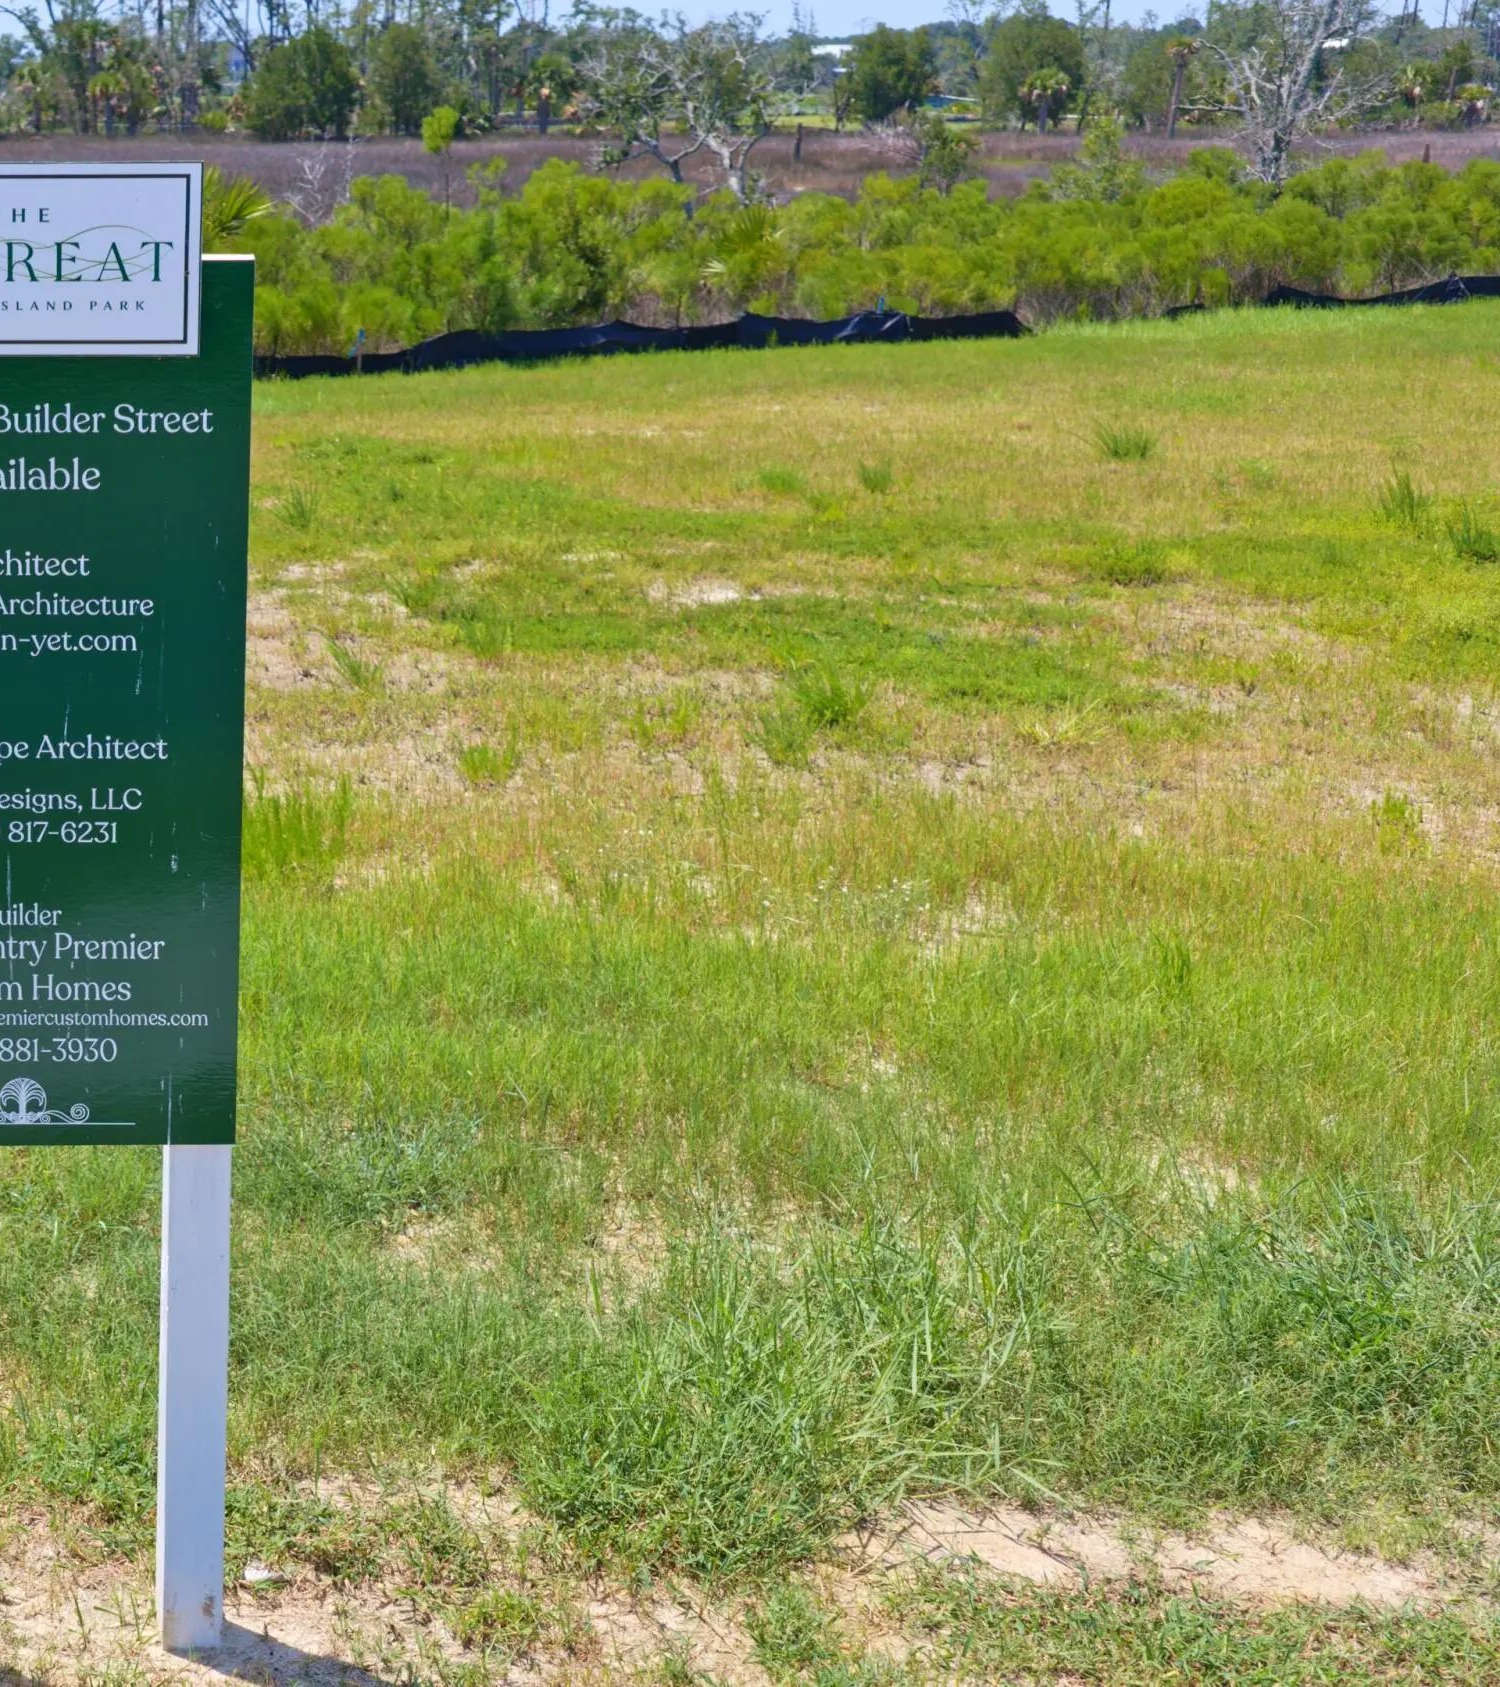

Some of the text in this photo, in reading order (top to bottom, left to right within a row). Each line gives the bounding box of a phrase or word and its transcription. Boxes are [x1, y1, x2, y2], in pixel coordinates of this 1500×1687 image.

[89, 299, 145, 312] PARK
[113, 403, 213, 434] Street
[35, 734, 168, 760] Architect
[91, 787, 142, 811] LLC
[8, 820, 117, 844] 817-6231
[54, 932, 166, 961] Premier
[32, 973, 132, 1001] Homes
